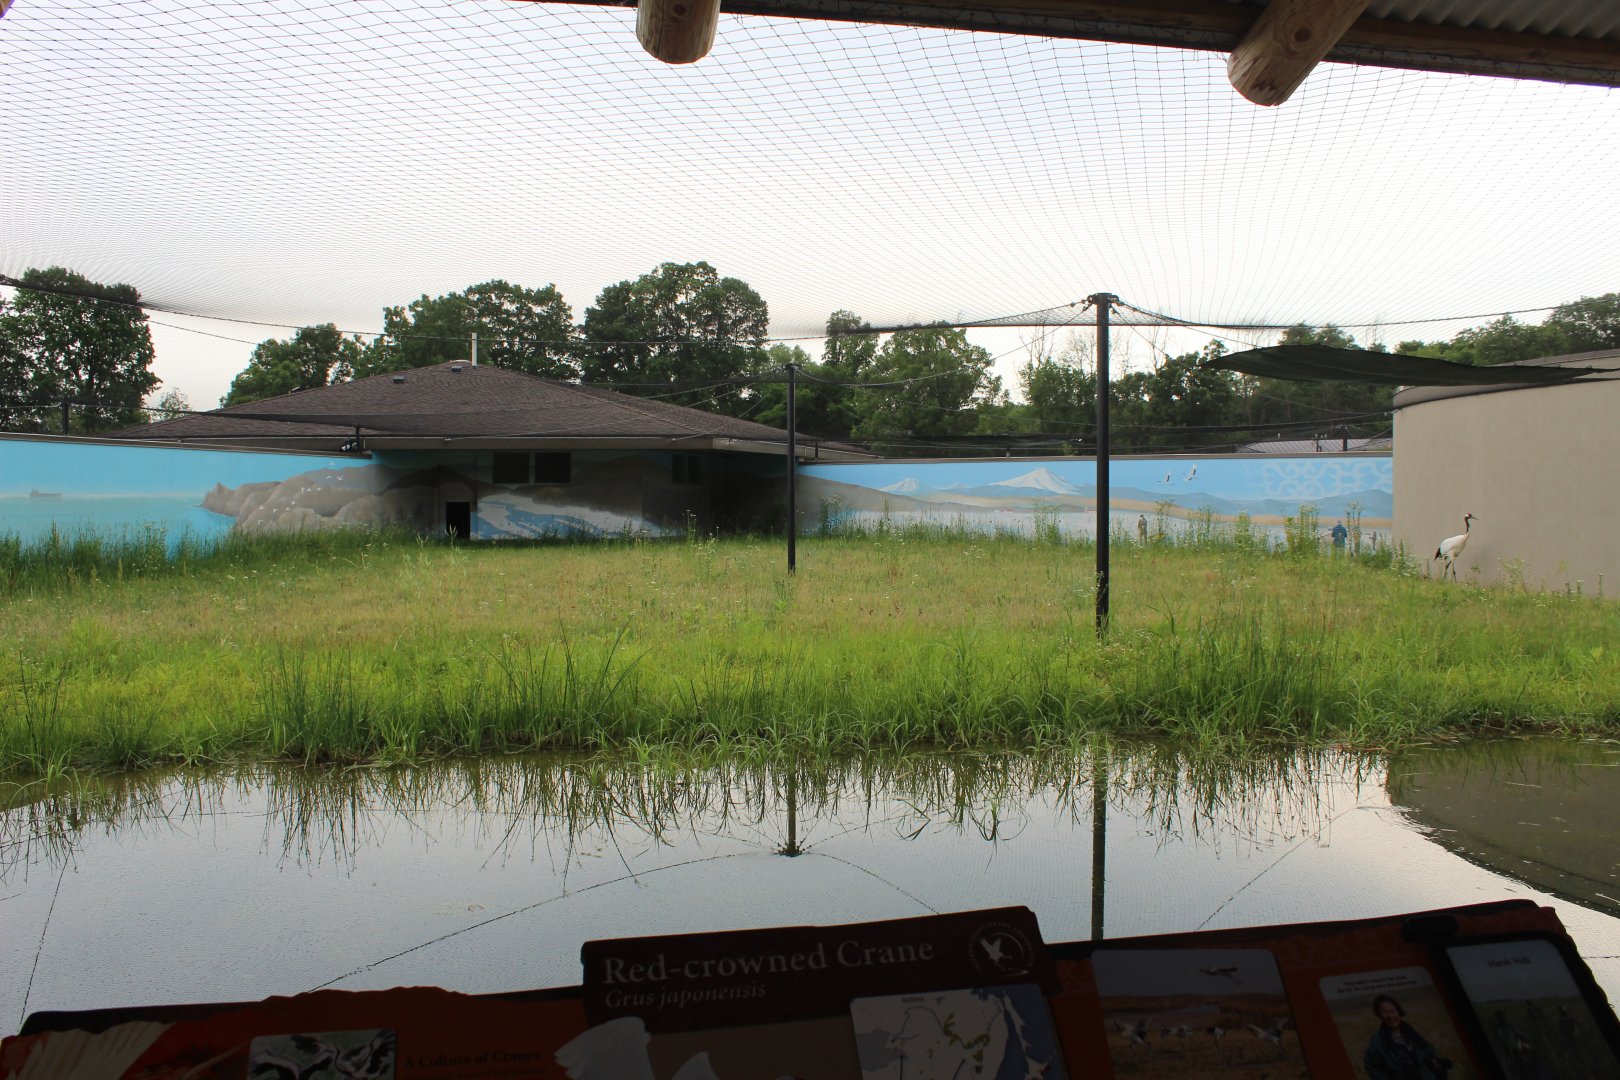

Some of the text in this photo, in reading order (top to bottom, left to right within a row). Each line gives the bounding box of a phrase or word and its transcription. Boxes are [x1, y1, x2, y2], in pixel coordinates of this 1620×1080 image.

[603, 942, 829, 985] Red-crowned
[837, 940, 934, 967] Crane
[605, 979, 766, 1009] Grus japonensis
[404, 1050, 540, 1069] A Culture of Cranes
